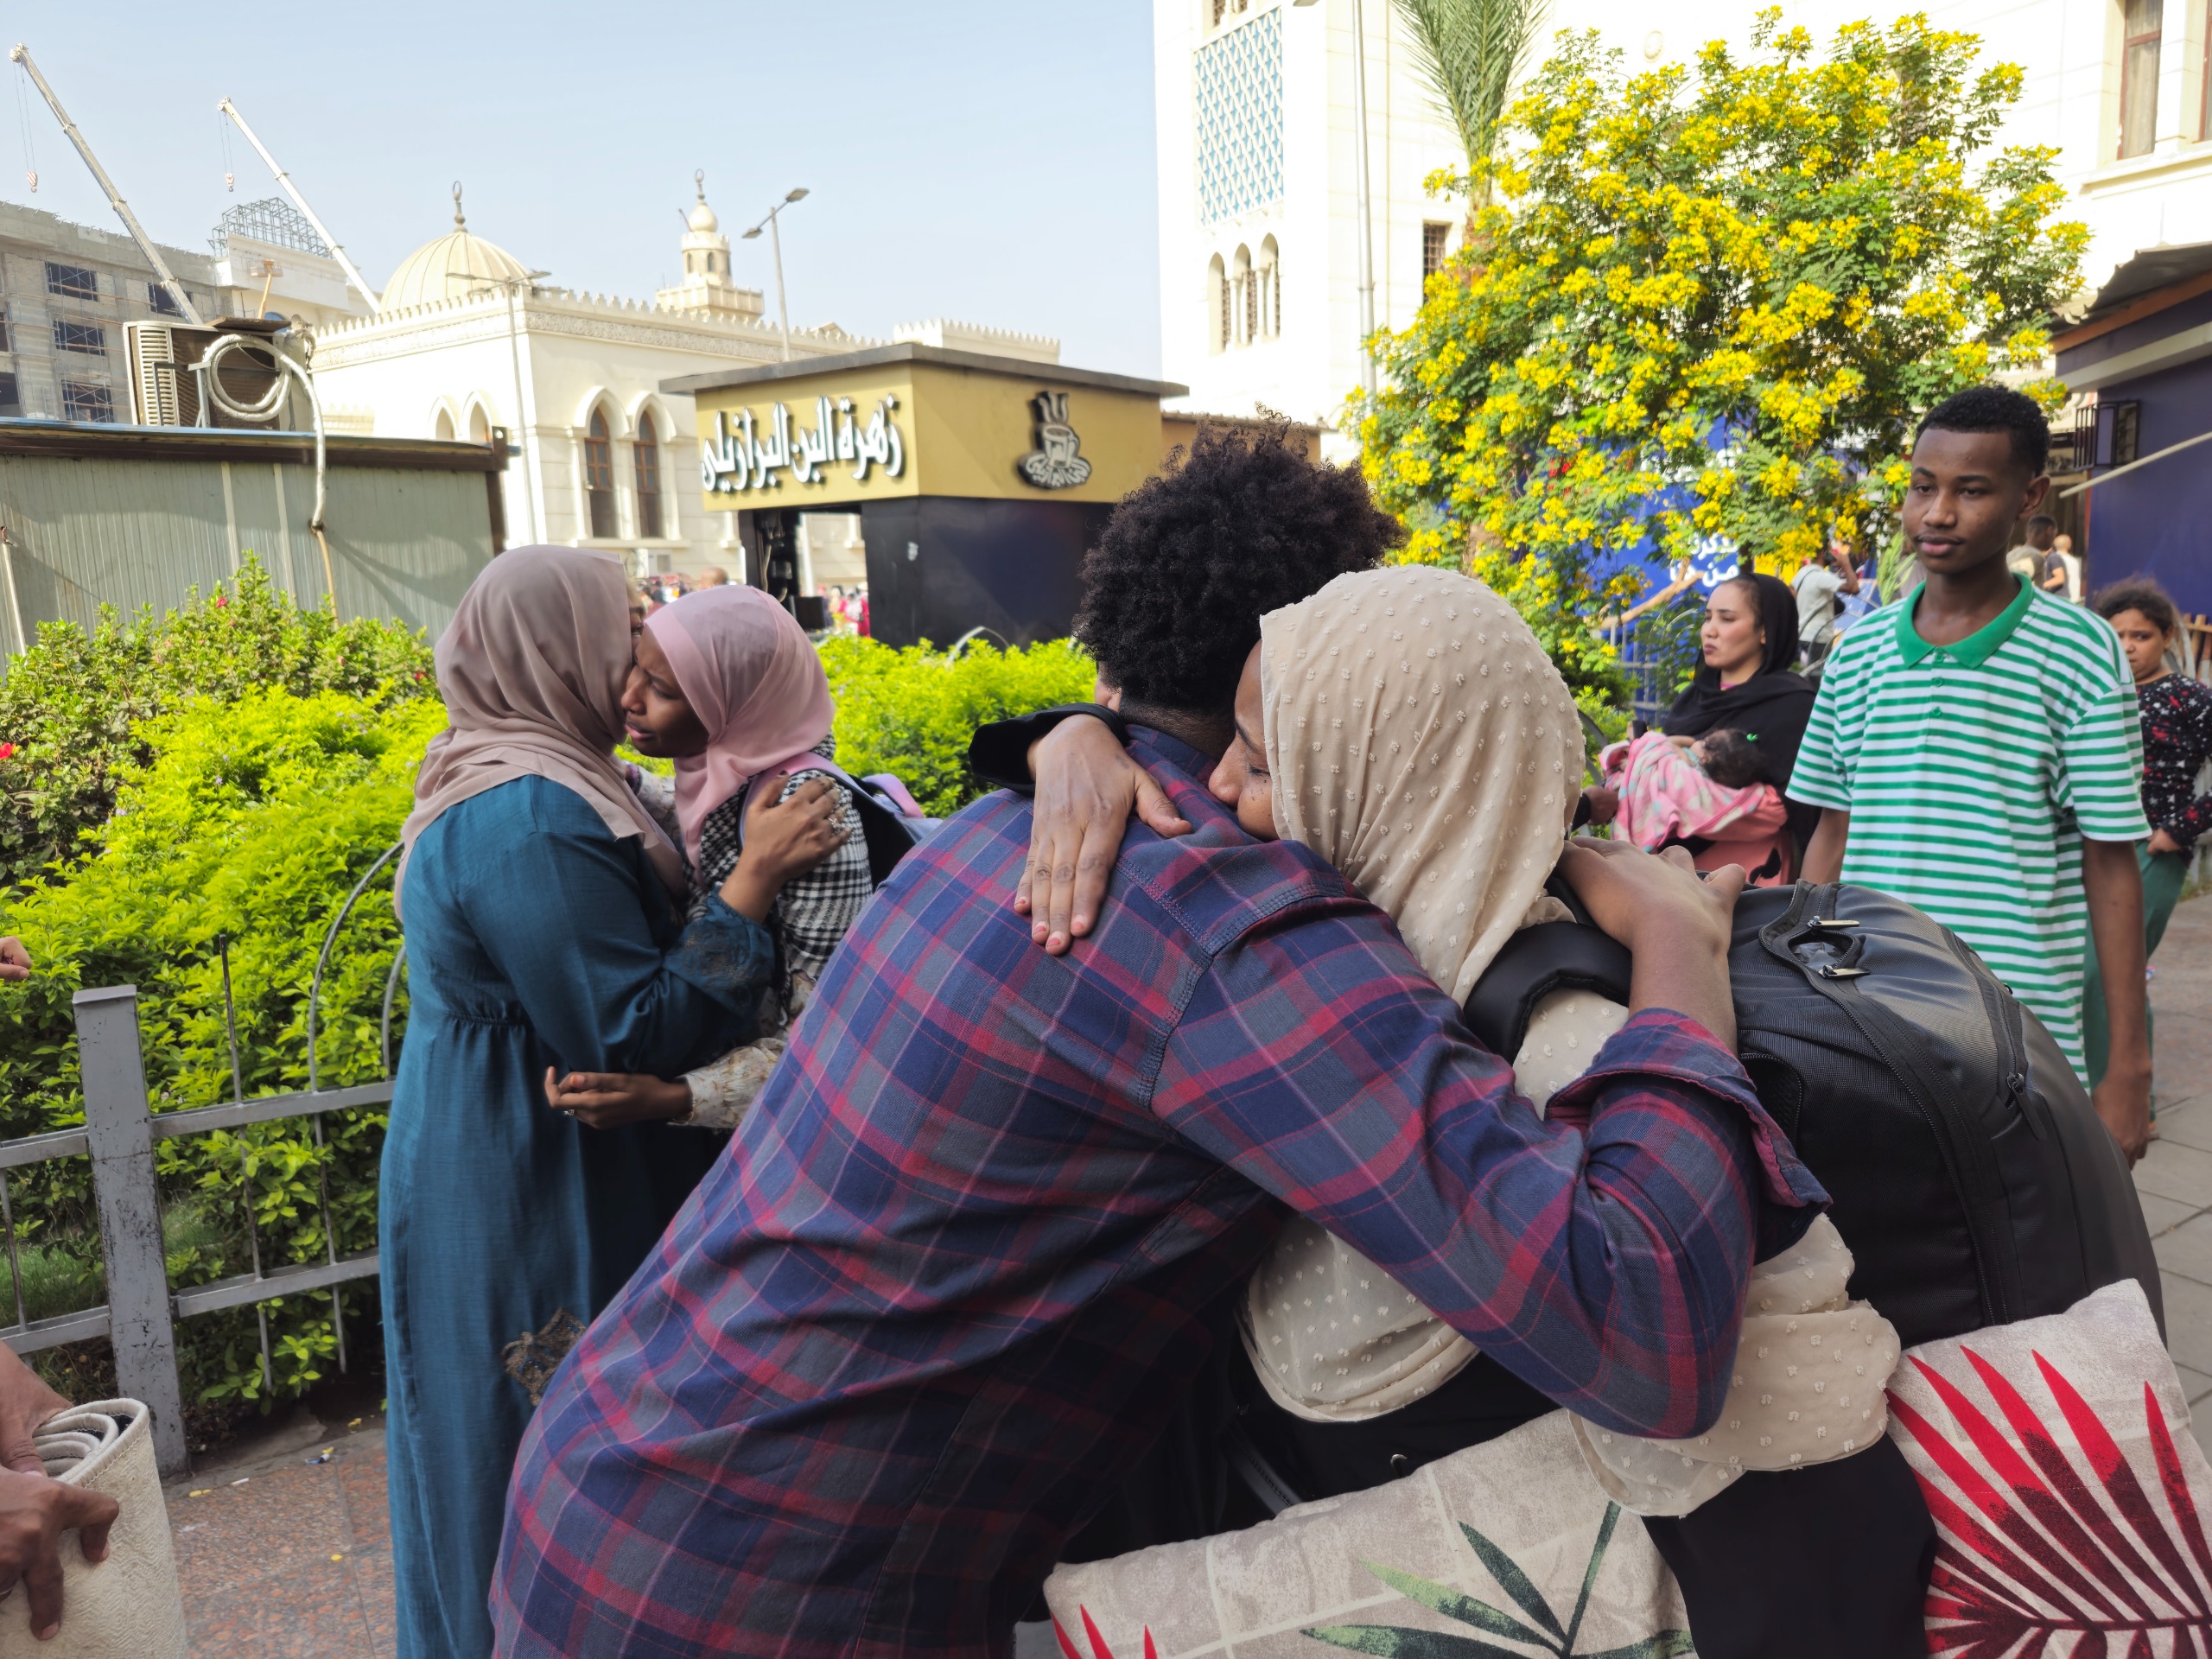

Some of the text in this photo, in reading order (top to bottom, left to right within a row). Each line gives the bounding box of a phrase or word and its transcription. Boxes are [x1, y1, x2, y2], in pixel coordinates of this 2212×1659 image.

[791, 395, 836, 484] البن
[837, 393, 902, 480] زهرة
[1701, 562, 1740, 588] من
